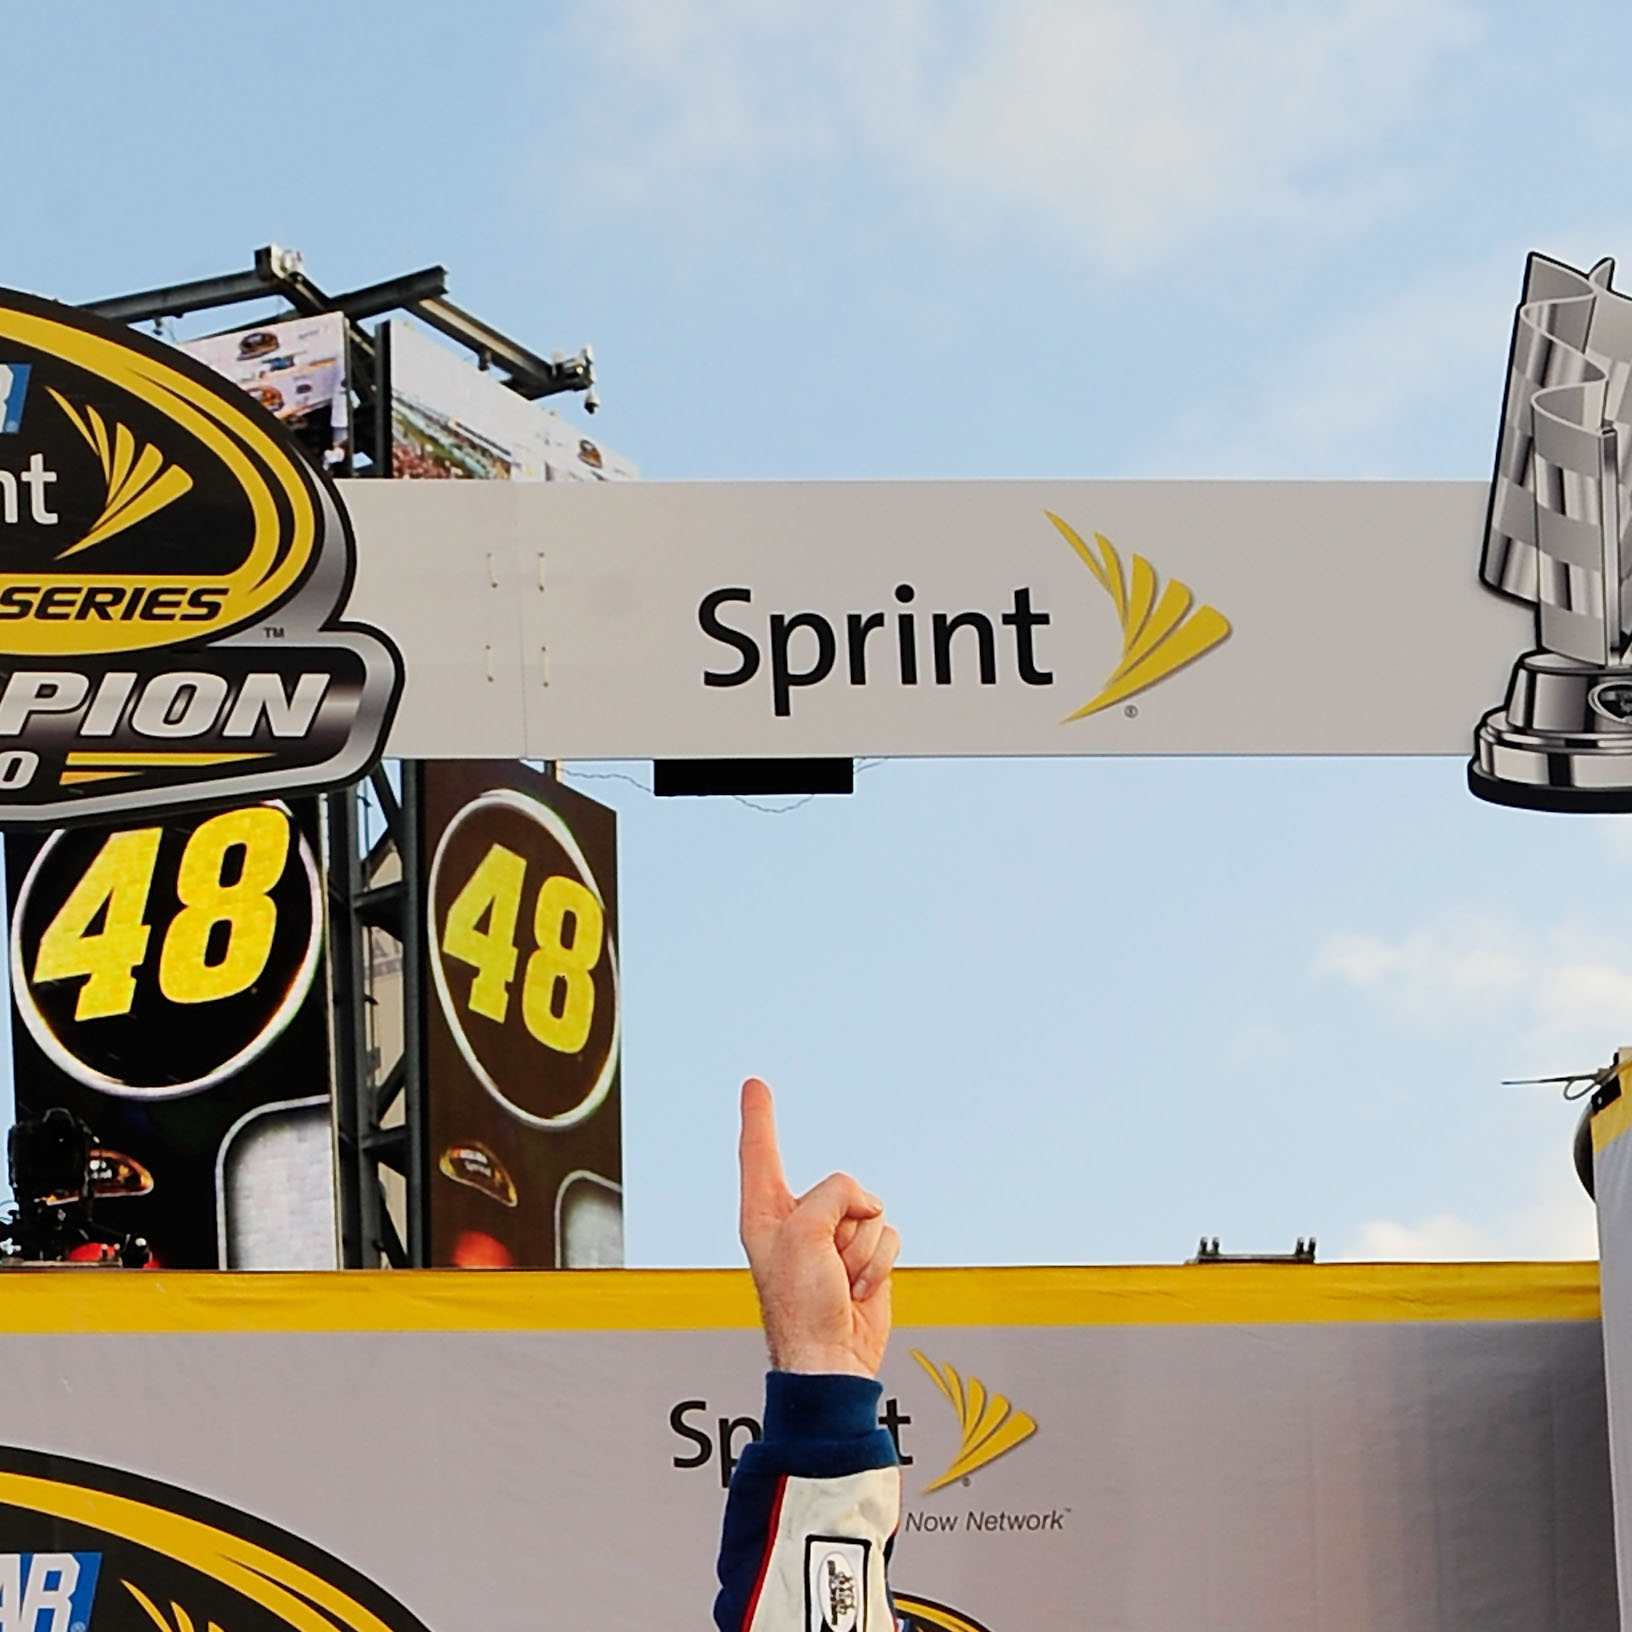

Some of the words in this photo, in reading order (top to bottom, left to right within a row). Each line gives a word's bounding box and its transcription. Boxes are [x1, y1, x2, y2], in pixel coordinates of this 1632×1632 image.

[697, 583, 1054, 719] Sprint
[32, 805, 291, 1023] 48
[442, 842, 605, 1055] 48
[669, 1399, 913, 1488] Spt
[905, 1509, 957, 1532] Now
[966, 1509, 1065, 1532] Network
